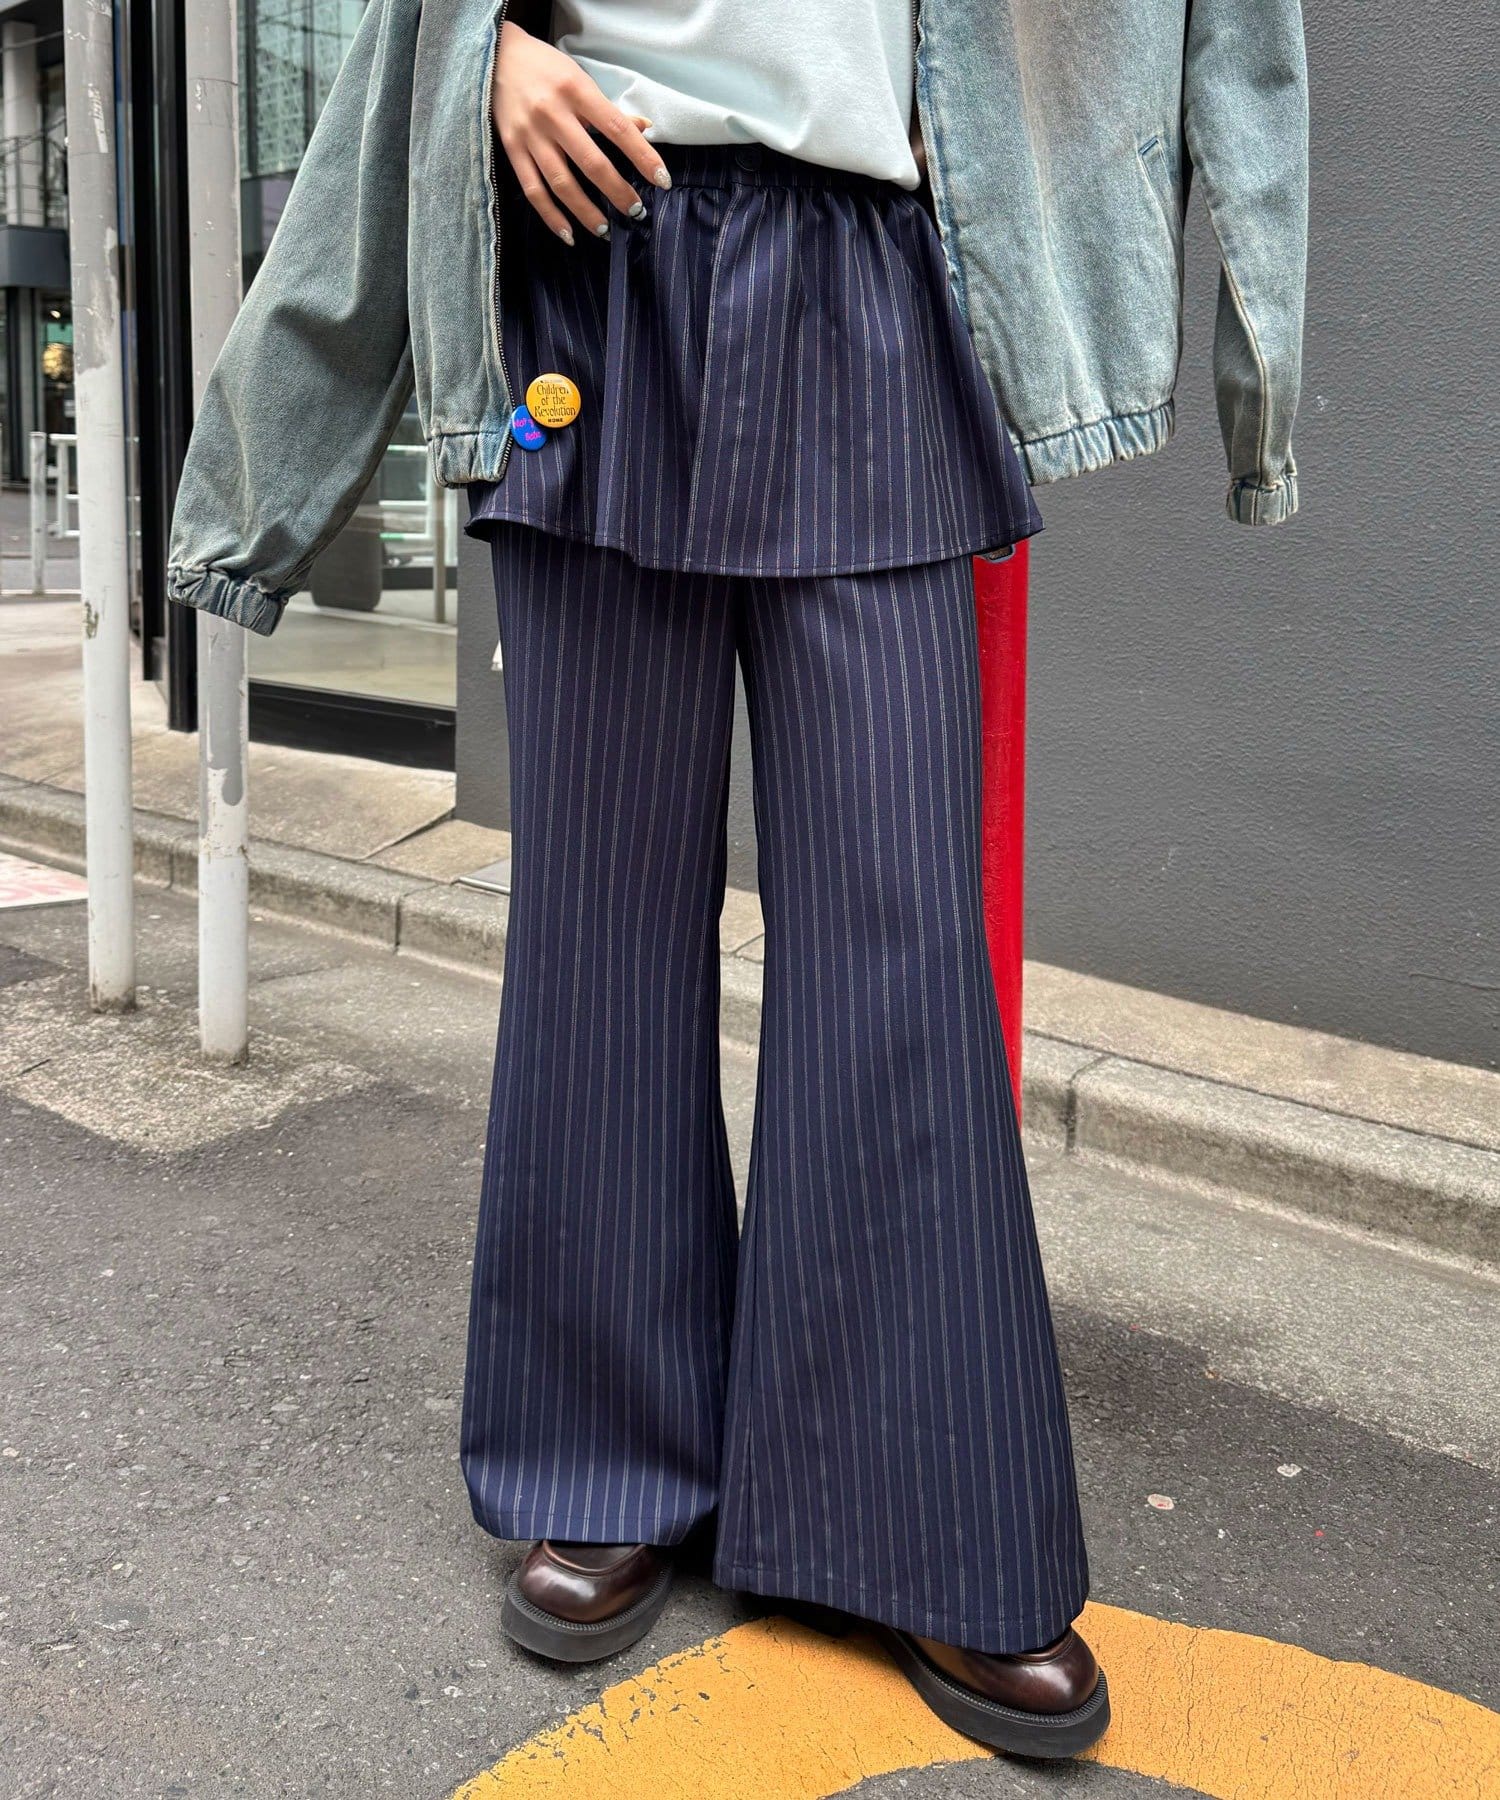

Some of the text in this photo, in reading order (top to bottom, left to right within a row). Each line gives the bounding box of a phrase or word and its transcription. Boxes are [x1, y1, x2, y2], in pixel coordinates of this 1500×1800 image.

[541, 395, 566, 406] of the
[534, 405, 576, 417] Revolution
